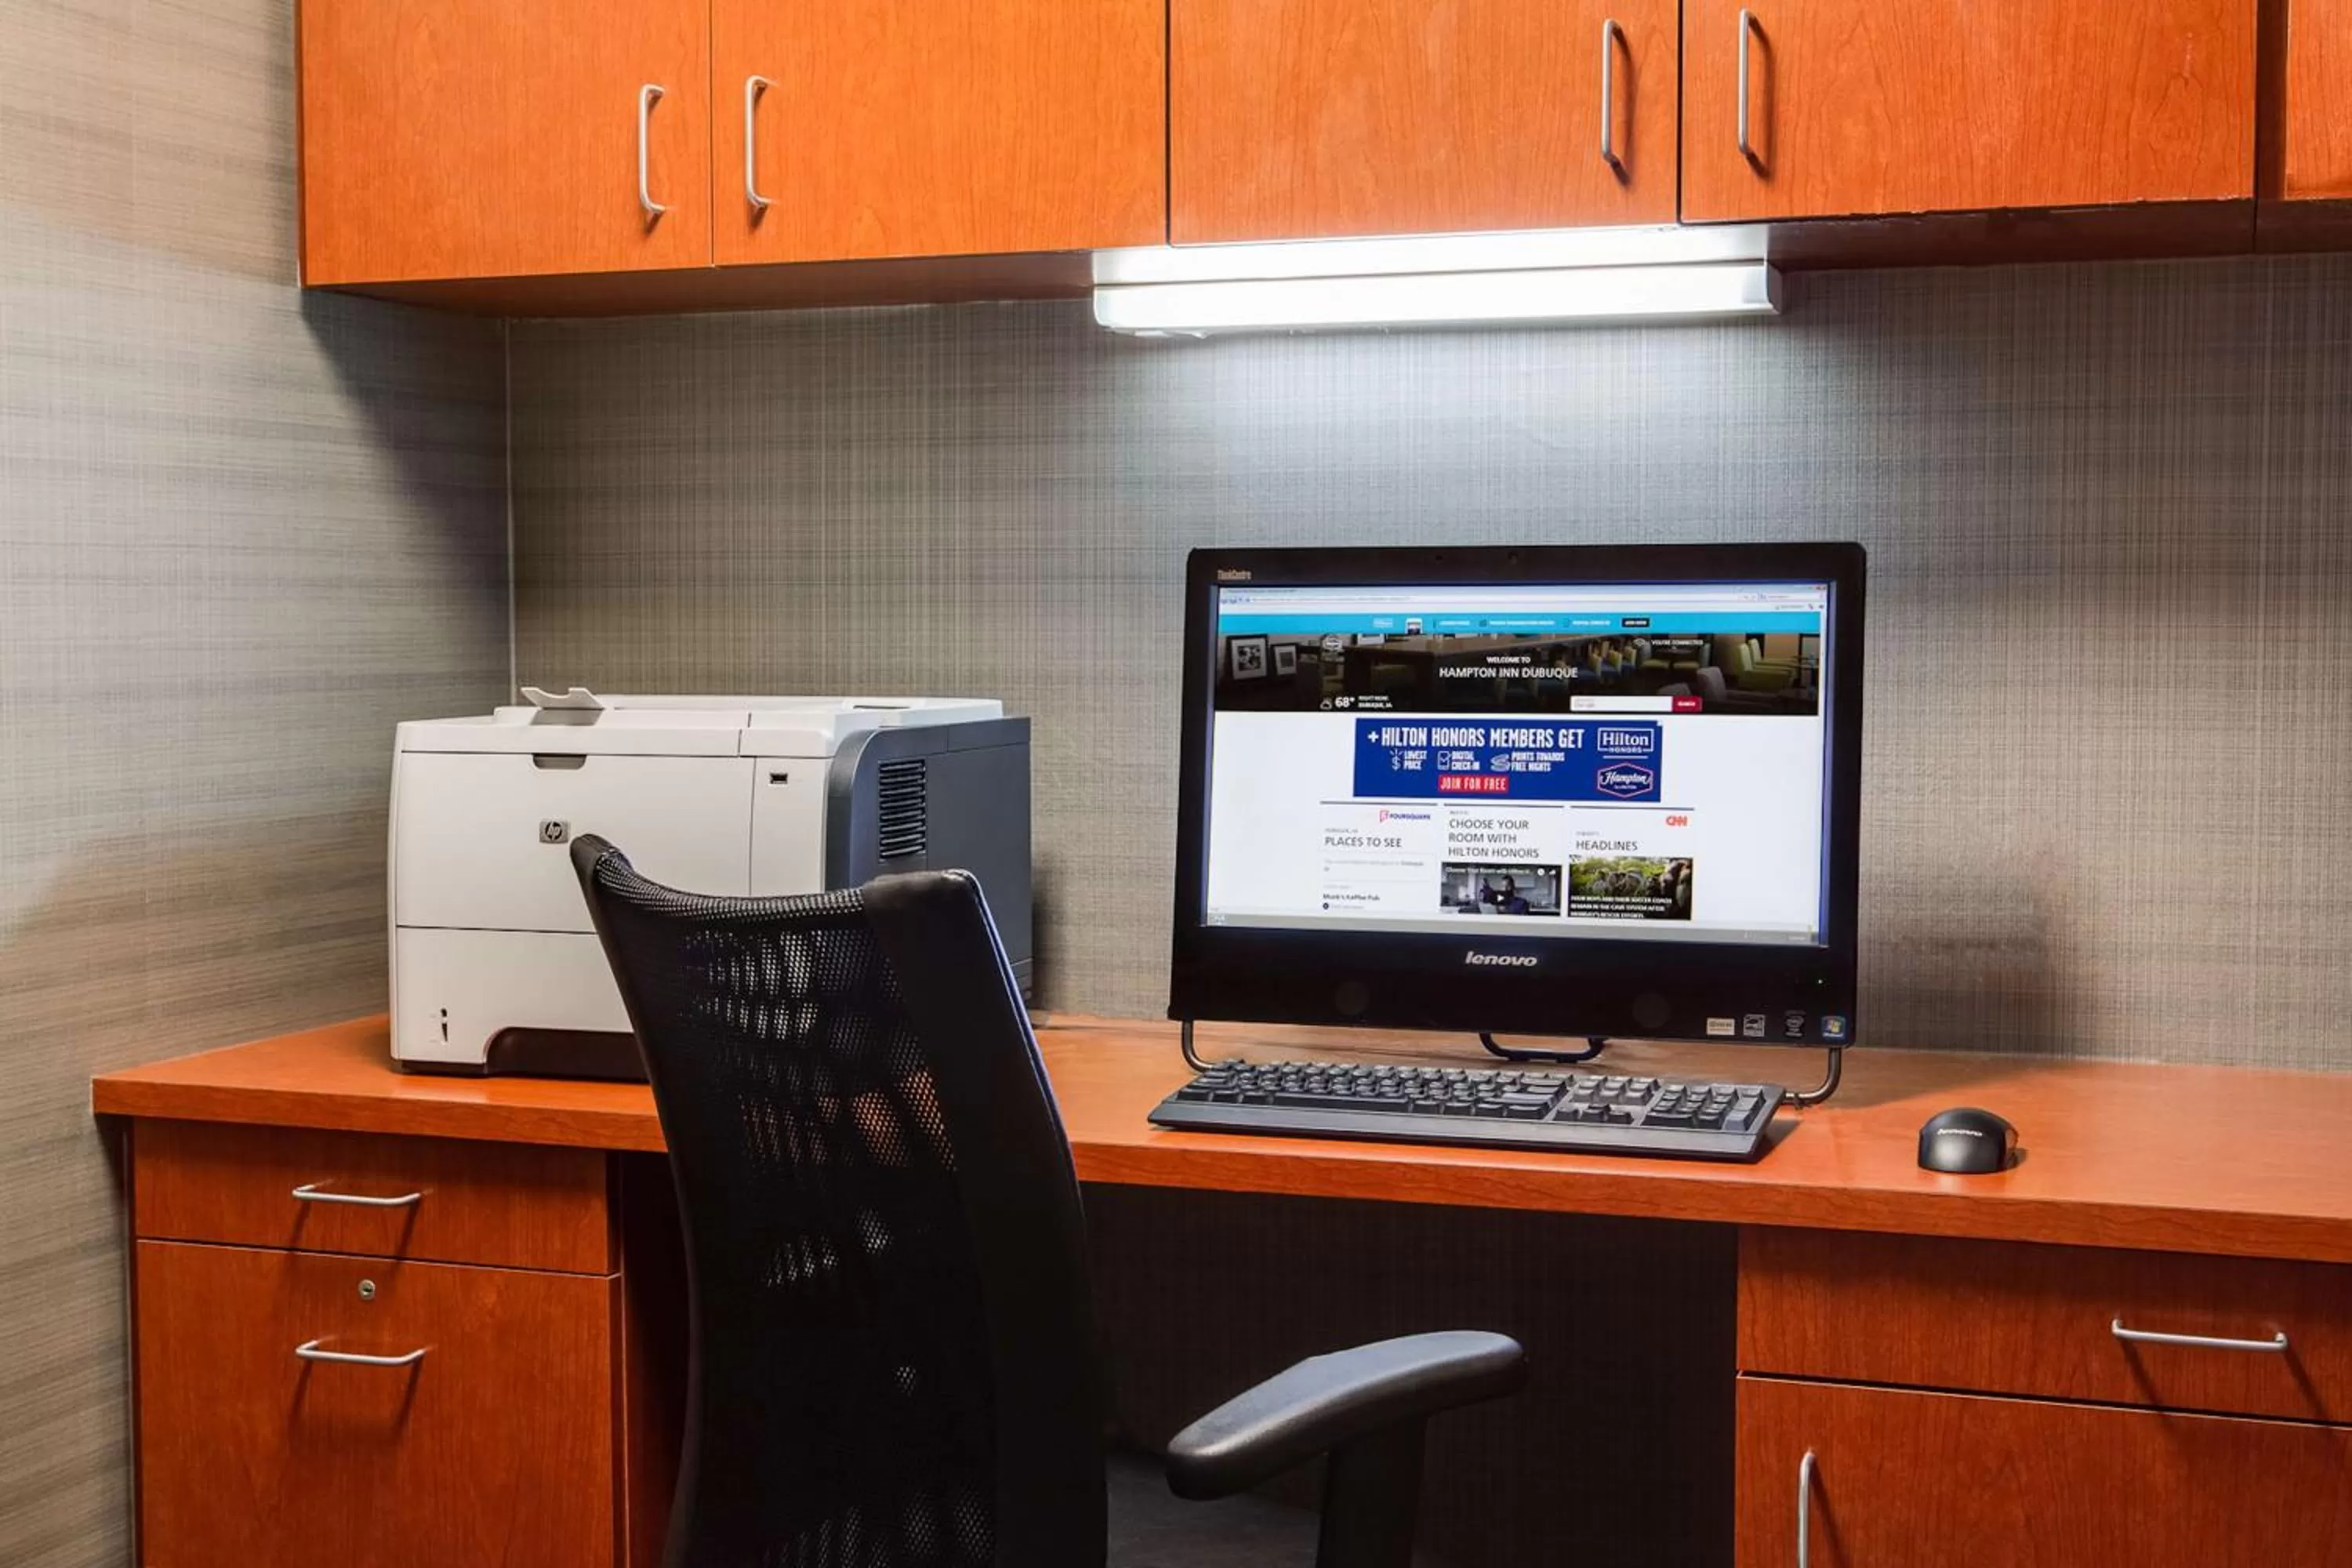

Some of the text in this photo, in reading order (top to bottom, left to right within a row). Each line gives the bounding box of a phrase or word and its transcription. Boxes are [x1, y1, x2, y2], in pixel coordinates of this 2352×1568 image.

[1439, 667, 1578, 680] HAMPTON INN DUBUQUE
[1381, 727, 1428, 747] HILTON
[1431, 728, 1486, 748] HONORS
[1490, 728, 1554, 749] MEMBERS
[1559, 729, 1584, 749] GET
[1602, 731, 1650, 746] Hilton
[1404, 750, 1428, 760] LOWEST
[1511, 752, 1565, 761] POINTS TOWARDS
[1403, 760, 1421, 770] PRICE
[1451, 760, 1480, 771] CHECK-IN
[1511, 761, 1552, 772] FREE NIGHTS
[1440, 775, 1507, 790] JOIN FOR FREE
[1601, 771, 1650, 785] Hampton
[1450, 818, 1530, 829] CHOOSE YOUR
[1665, 815, 1688, 826] CNN
[1324, 836, 1402, 848] PLACES TO SEE
[1449, 833, 1517, 844] ROOM WITH
[1575, 840, 1639, 851] HEADLINES
[1448, 847, 1540, 858] HILTON HONORS
[1465, 950, 1537, 967] lenovo
[1937, 1128, 1983, 1137] lenovo
